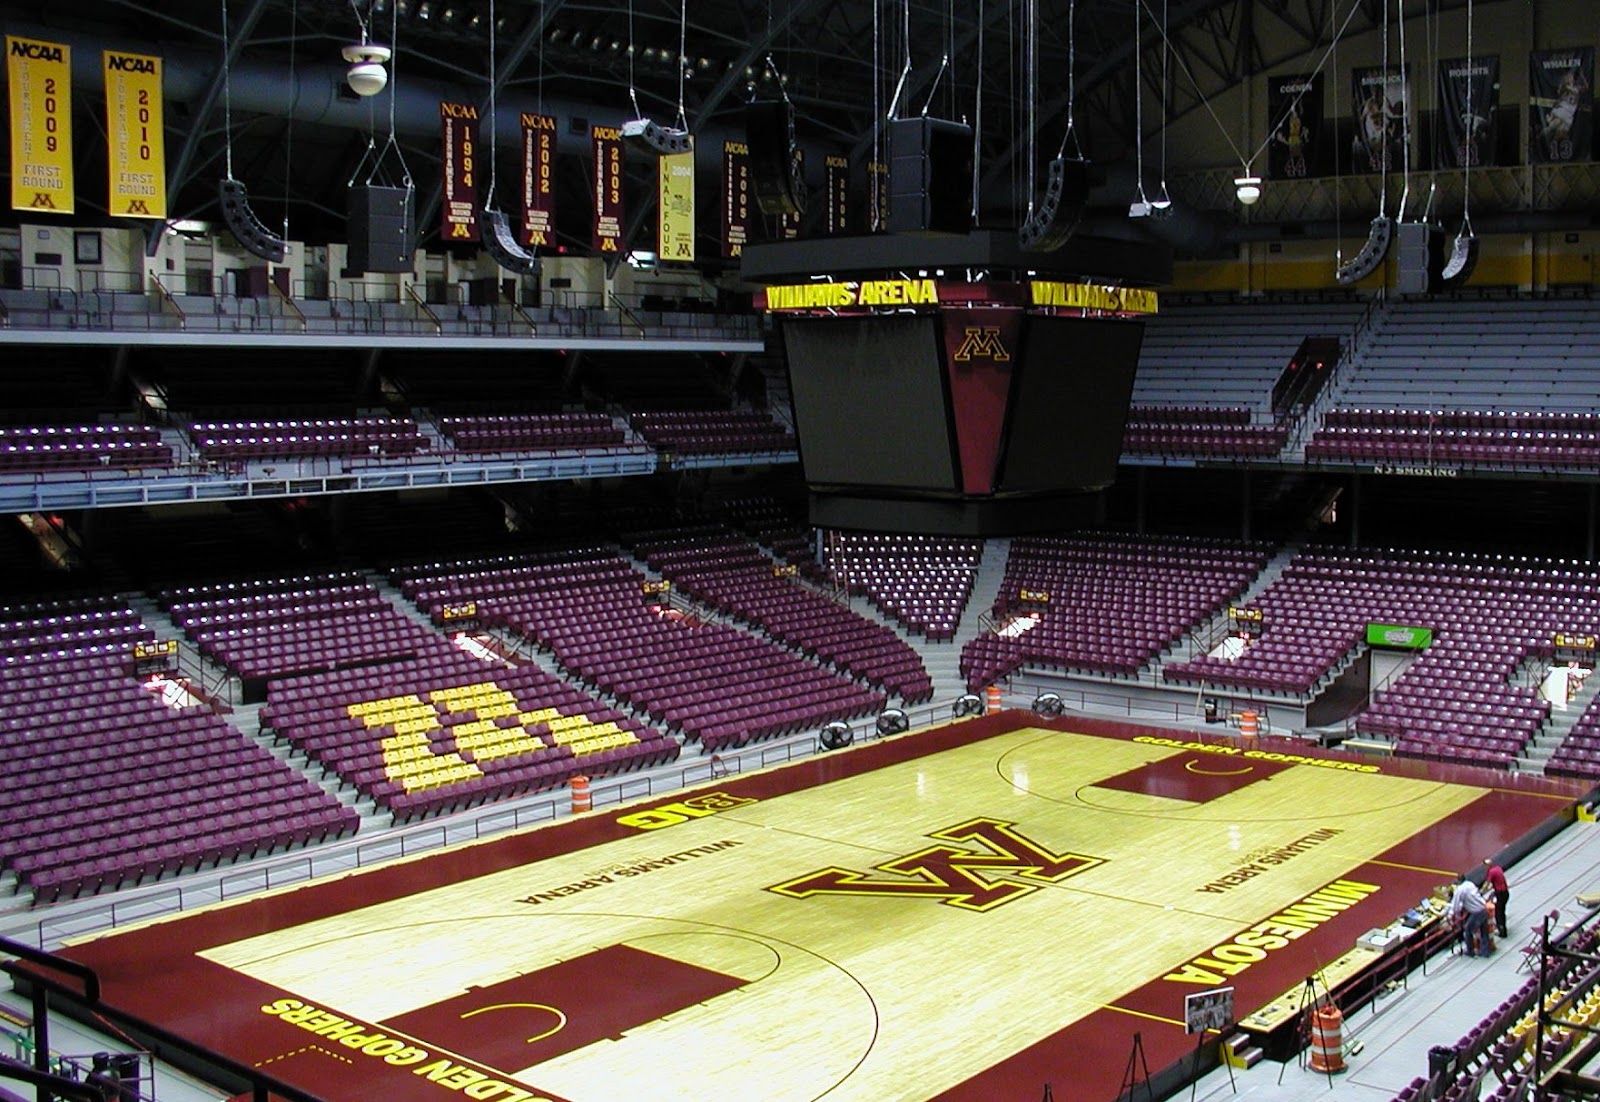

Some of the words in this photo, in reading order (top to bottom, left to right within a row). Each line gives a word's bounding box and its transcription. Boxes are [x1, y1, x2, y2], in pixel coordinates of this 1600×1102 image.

[11, 41, 63, 63] NCAA
[108, 55, 155, 75] NCAA
[1542, 57, 1582, 70] WHALEN
[1361, 75, 1403, 87] SHUDICK
[44, 78, 57, 152] 2009
[441, 101, 477, 120] NCAA
[138, 89, 150, 160] 2010
[521, 113, 555, 131] NCAA
[593, 126, 621, 142] NCAA
[462, 126, 474, 187] 1994
[724, 141, 749, 156] NCAA
[1549, 138, 1574, 160] 13
[24, 164, 61, 176] FIRST
[540, 134, 551, 193] 2002
[672, 165, 693, 178] 2004
[825, 155, 848, 169] NCAA
[22, 176, 64, 189] ROUND
[120, 172, 154, 184] FIRST
[610, 148, 620, 205] 2003
[662, 154, 672, 207] INAL
[30, 192, 55, 210] M
[118, 184, 156, 196] ROUND
[739, 165, 748, 220] 2005
[126, 199, 150, 215] M
[451, 223, 471, 238] M
[662, 211, 671, 256] FOUR
[601, 237, 617, 251] M
[676, 242, 691, 257] M
[766, 280, 858, 310] WILLIAMS
[858, 279, 939, 307] ARENA
[1031, 281, 1121, 310] WILLIAMS
[954, 326, 1011, 361] M
[1395, 467, 1457, 477] SMOKING
[1132, 735, 1242, 756] GOLDEN
[1243, 750, 1382, 774] GOPHERS
[1257, 828, 1345, 866] WILLIAMS
[614, 839, 744, 879] WILLIAMS
[514, 874, 615, 906] ARENA
[1194, 863, 1269, 895] ARENA
[1162, 878, 1382, 985] MINNESOTA
[260, 997, 430, 1067] GOPHERS
[411, 1058, 558, 1102] LDEN
